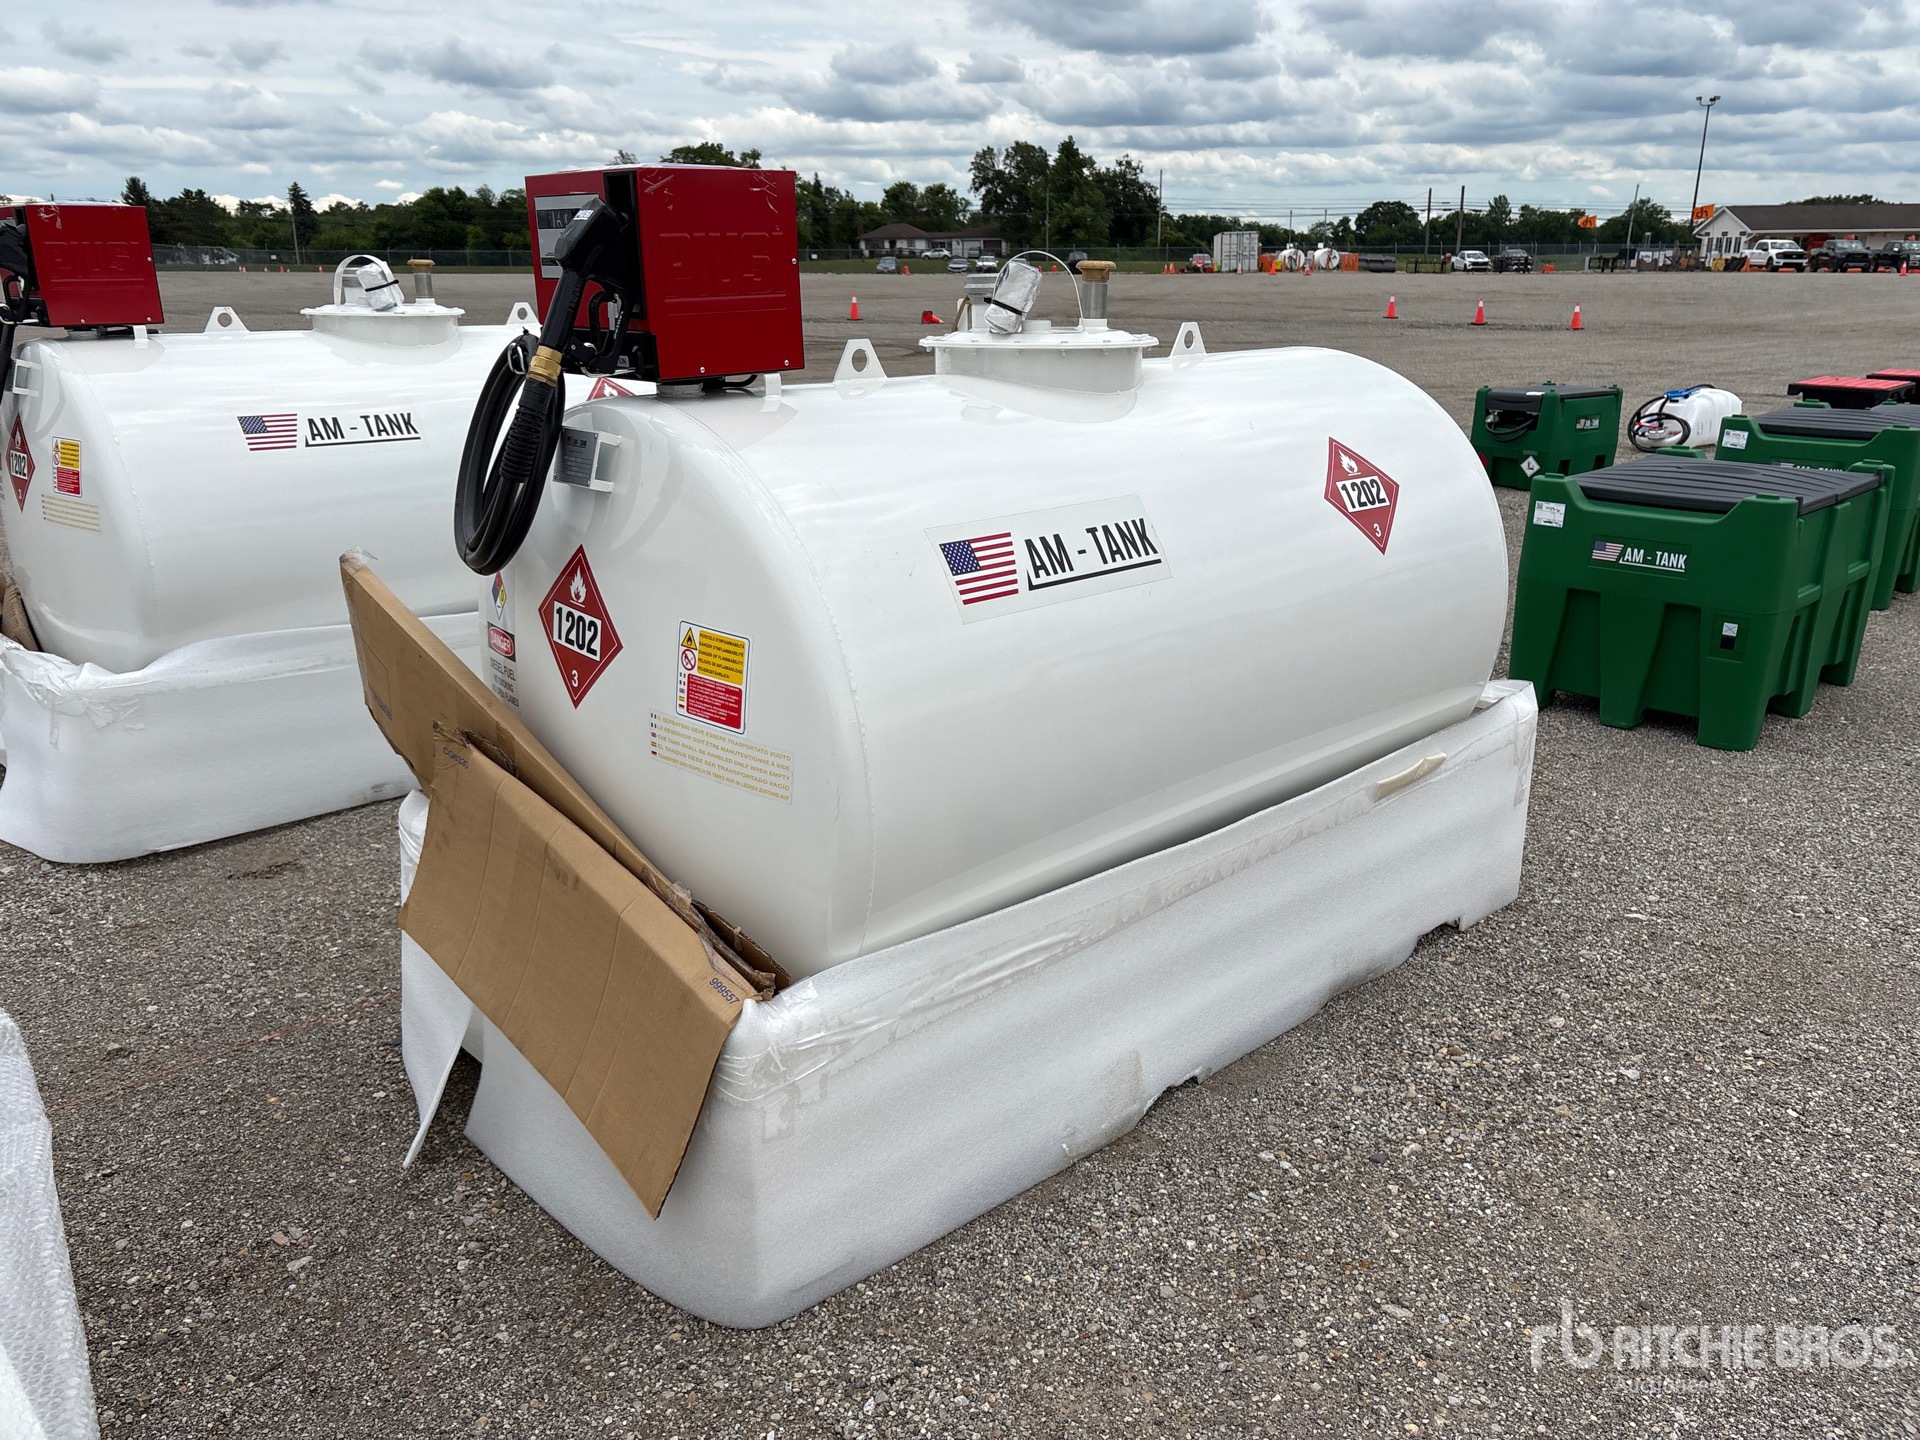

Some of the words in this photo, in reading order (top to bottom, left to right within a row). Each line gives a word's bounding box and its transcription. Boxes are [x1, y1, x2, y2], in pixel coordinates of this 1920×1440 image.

[307, 417, 345, 441] AM
[360, 413, 419, 437] TANK
[10, 452, 27, 477] 1202
[1341, 479, 1387, 509] 1202
[1373, 523, 1382, 538] 3
[1024, 533, 1074, 579] AM
[1085, 518, 1159, 565] TANK
[1624, 547, 1645, 563] AM
[1655, 551, 1688, 569] TANK
[491, 631, 512, 652] DANGER
[556, 607, 599, 657] 1202
[698, 649, 711, 657] DANGER
[490, 658, 503, 676] DIESEL
[503, 666, 516, 681] FUEL
[571, 669, 579, 688] 3
[662, 717, 690, 730] SERBATOIO
[691, 726, 704, 735] DEVE
[705, 730, 726, 742] ESSERE
[728, 737, 768, 755] TRASPORTATO
[770, 749, 790, 762] VUOTO
[665, 746, 686, 758] TANQUE
[704, 759, 716, 768] SER
[717, 763, 766, 784] TRANSPORTADO
[668, 737, 680, 746] TANK
[706, 751, 732, 764] HANDLED
[734, 759, 748, 769] ONLY
[750, 764, 767, 775] WHEN
[769, 770, 789, 781] EMPTY
[692, 736, 705, 745] DOIT
[776, 762, 790, 771] VIDE
[709, 977, 740, 1004] 999557
